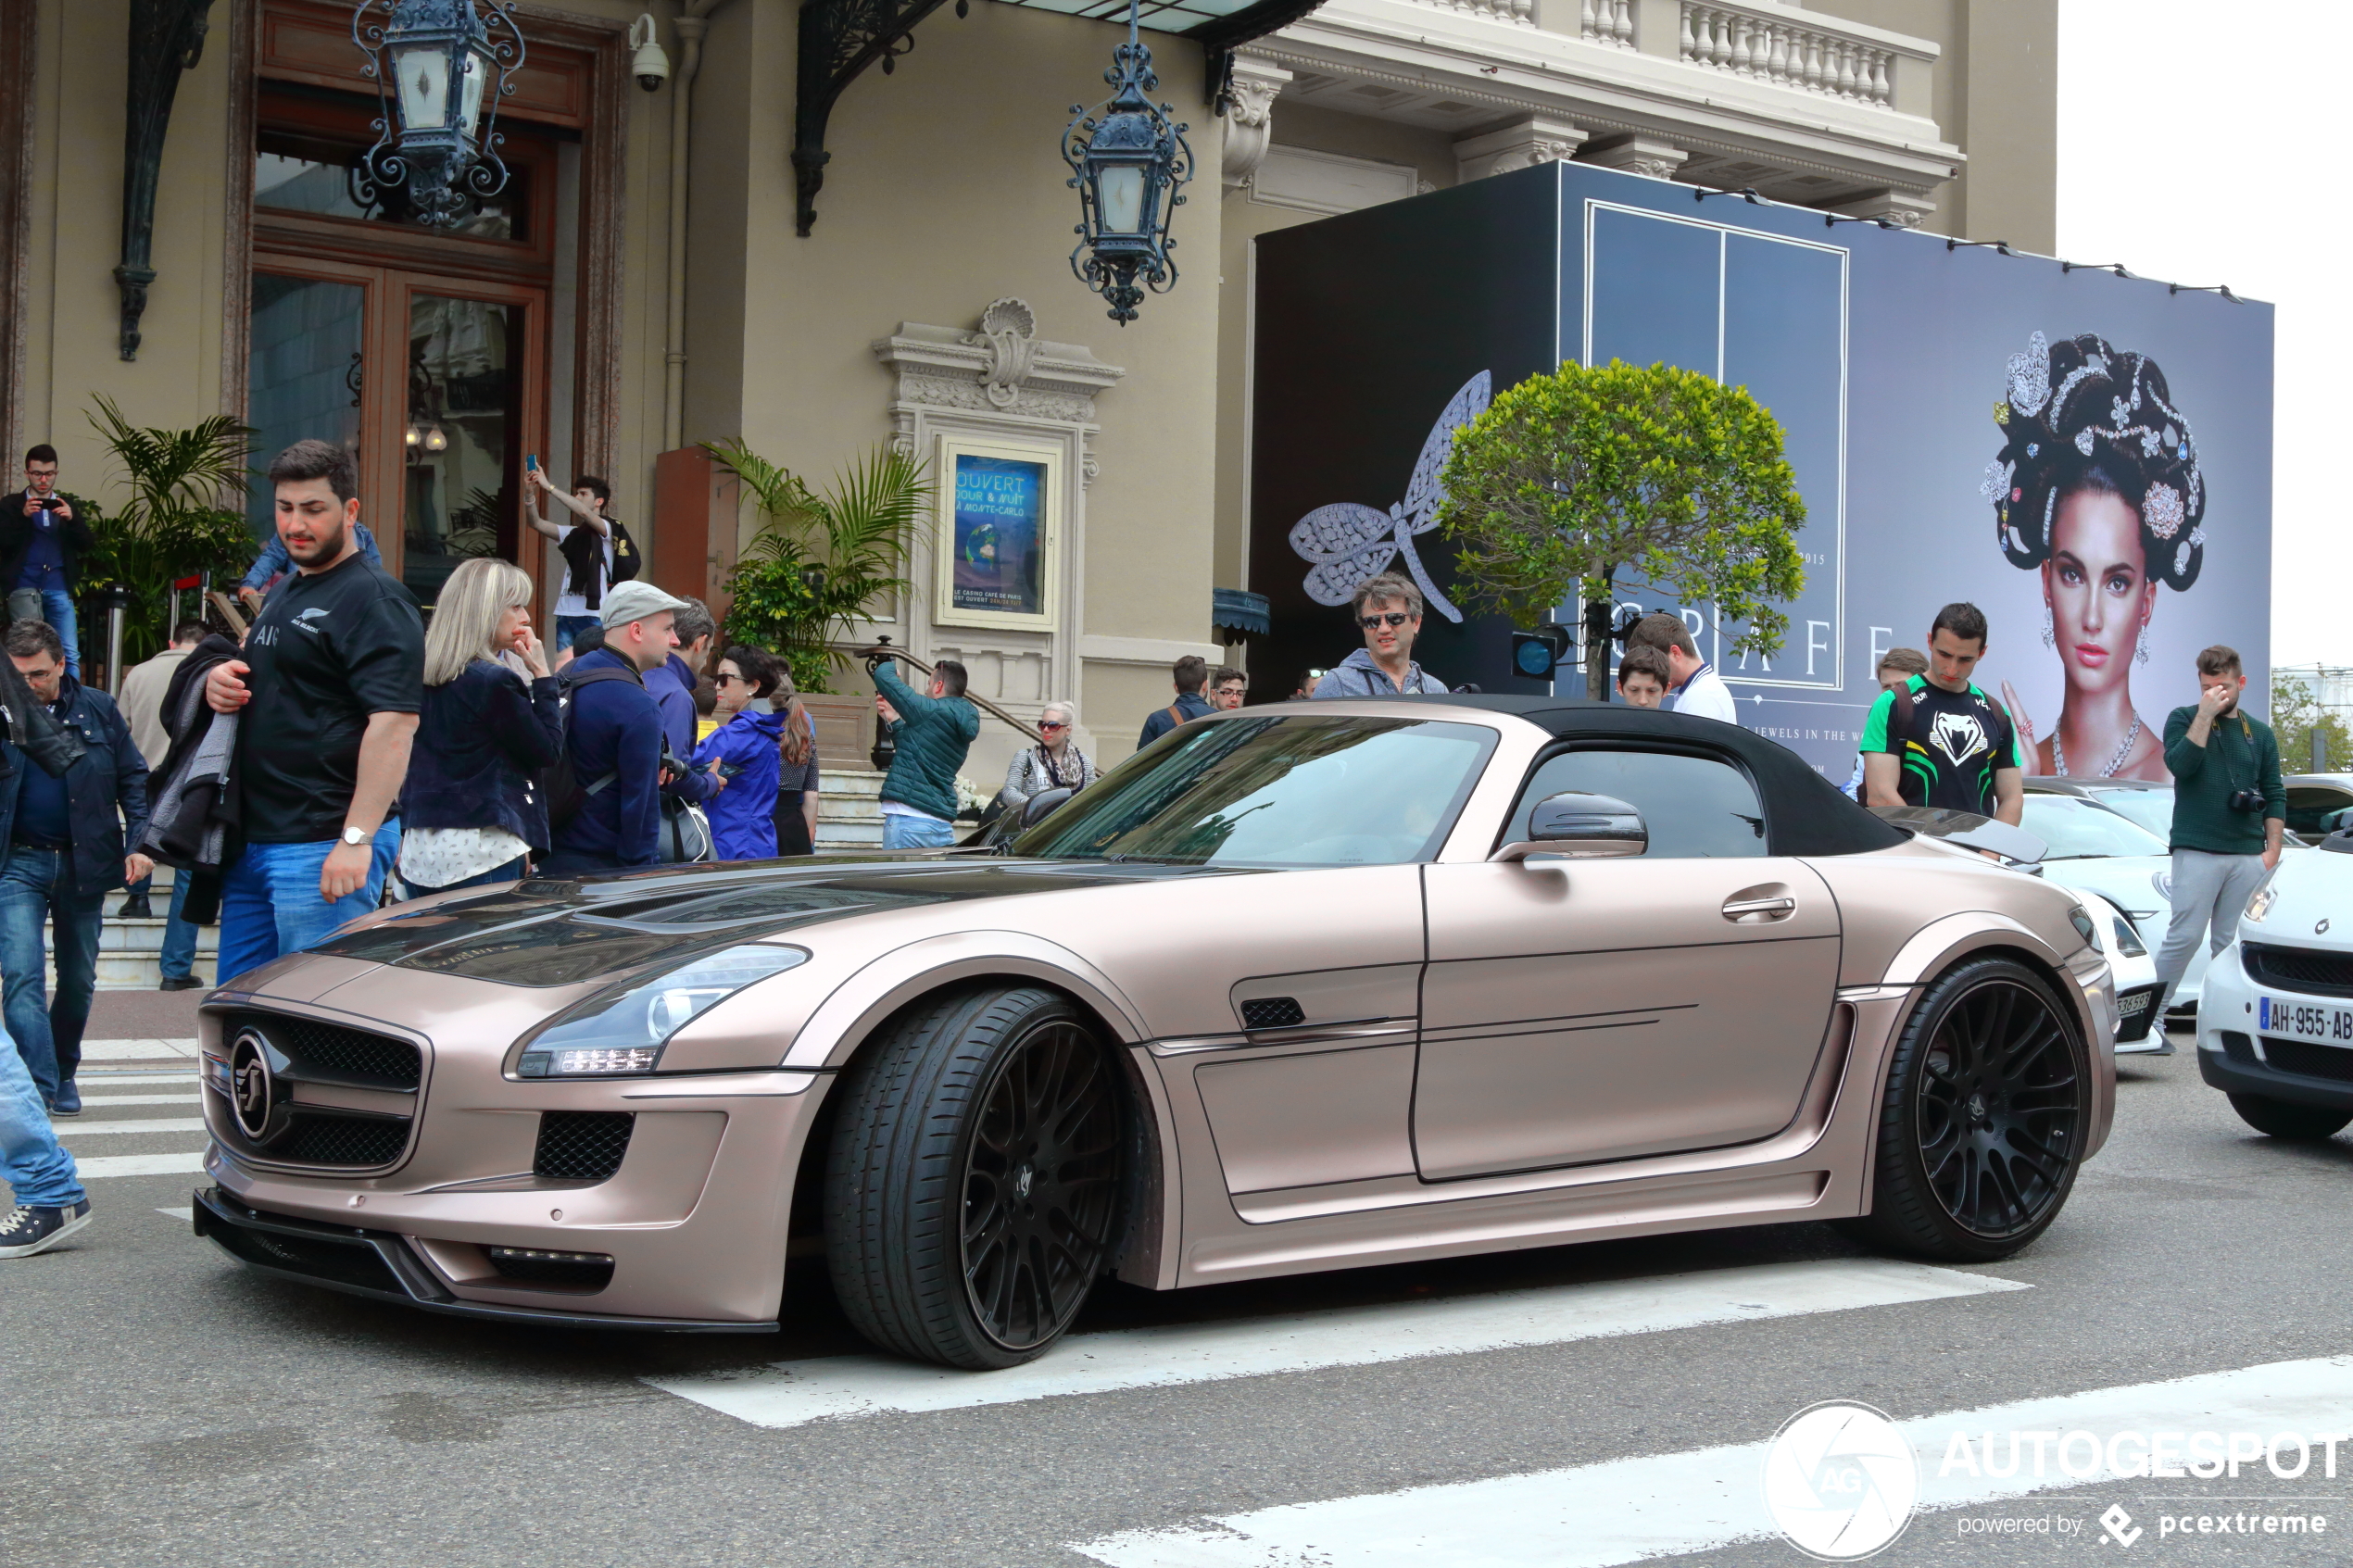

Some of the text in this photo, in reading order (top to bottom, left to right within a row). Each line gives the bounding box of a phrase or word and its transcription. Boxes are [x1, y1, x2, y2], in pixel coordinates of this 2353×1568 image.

[956, 471, 1025, 493] OUVERT
[988, 492, 995, 502] &
[999, 493, 1025, 505] NUIT
[964, 503, 1025, 517] MONTE-CARLO
[963, 589, 984, 597] CASINO
[1755, 726, 1800, 739] JEWELS
[1806, 729, 1818, 740] IN
[1824, 730, 1845, 742] THE
